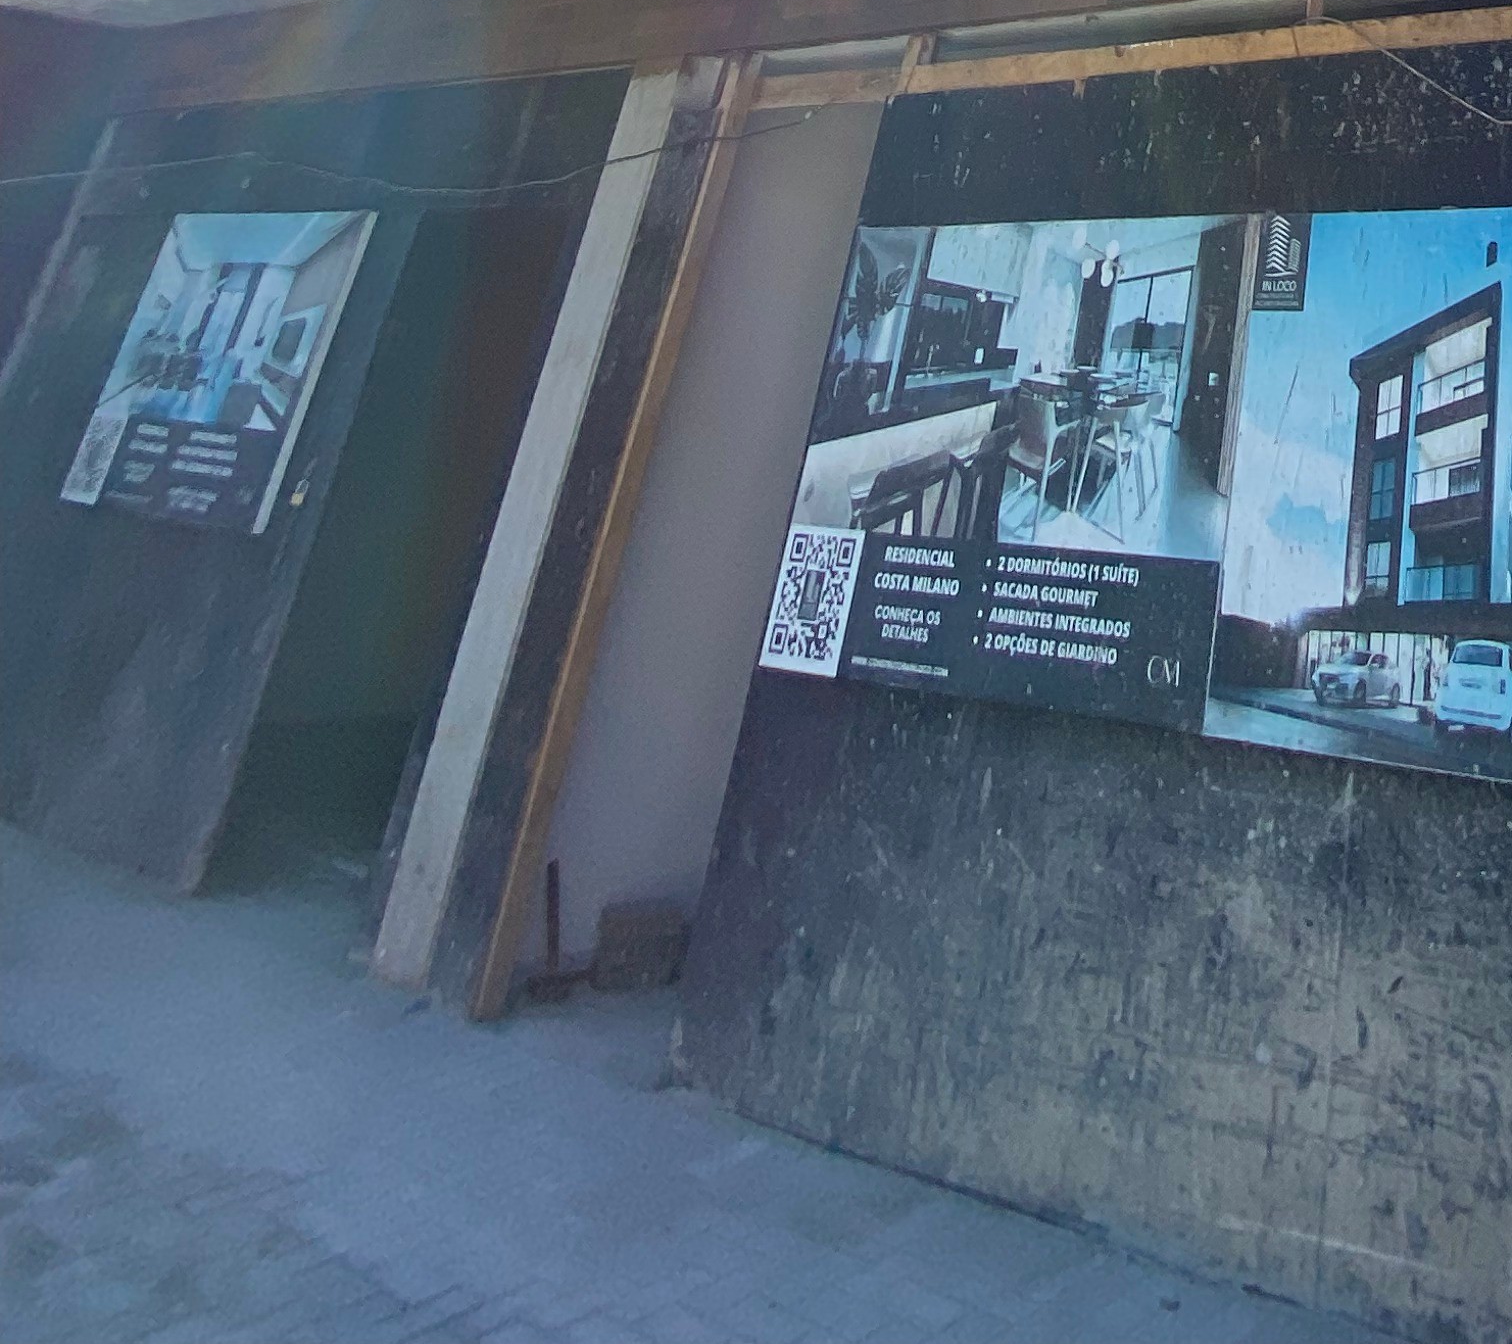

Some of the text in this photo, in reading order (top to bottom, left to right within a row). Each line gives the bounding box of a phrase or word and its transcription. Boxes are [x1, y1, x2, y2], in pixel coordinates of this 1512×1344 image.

[884, 545, 955, 568] RESIDENCIAL
[874, 572, 960, 596] COSTA MILANO
[997, 556, 1140, 587] 2 DORMITÓRIOS (1 SUÍTE)
[993, 581, 1099, 607] SACADA GOURMET
[874, 605, 941, 625] CONHEÇA OS
[988, 607, 1131, 638] AMBIENTES INTEGRADOS
[881, 623, 929, 643] DETALHES
[984, 632, 1118, 665] 2 OPÇÕES DE GIARDINO
